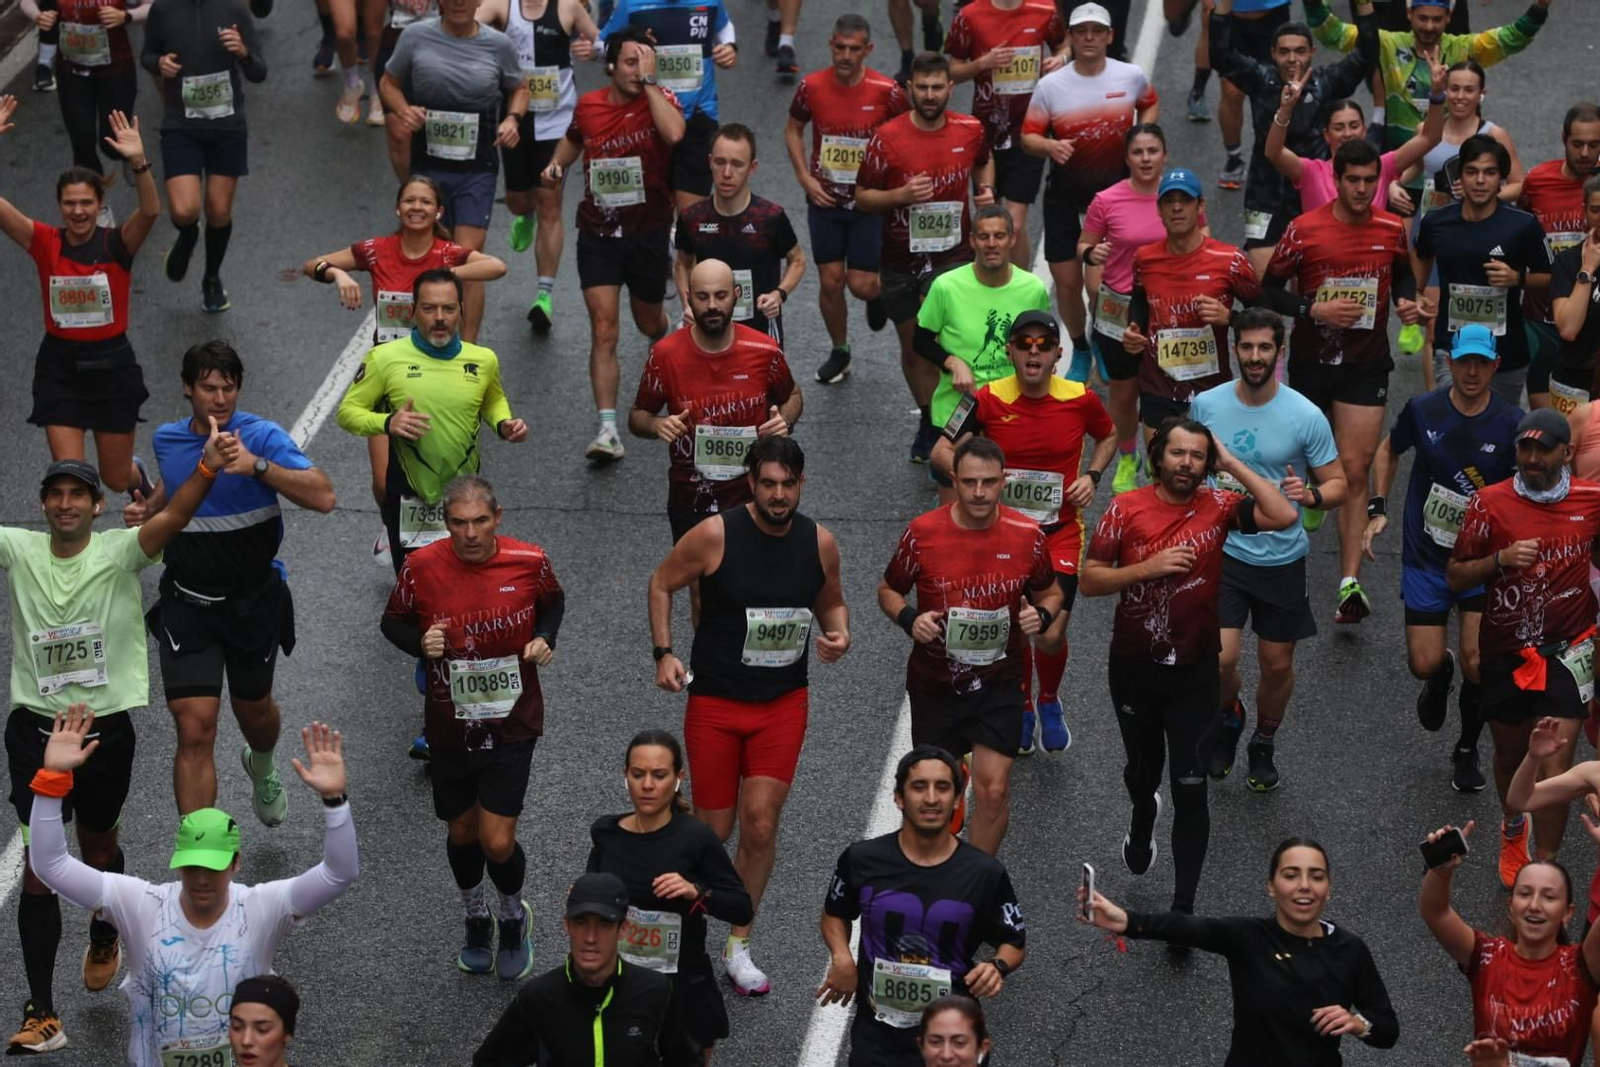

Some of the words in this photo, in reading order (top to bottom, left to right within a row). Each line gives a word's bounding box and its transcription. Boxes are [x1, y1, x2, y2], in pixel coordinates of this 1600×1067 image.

[689, 15, 708, 27] CN
[690, 27, 707, 38] PN
[659, 56, 691, 72] 9350
[190, 84, 222, 101] 7356
[433, 122, 466, 139] 9821
[825, 147, 865, 164] 12019
[597, 170, 630, 186] 9190
[918, 214, 951, 230] 8242
[58, 289, 96, 305] 8804
[1456, 297, 1494, 314] 9075
[1162, 340, 1208, 359] 14739
[705, 439, 744, 457] 9869
[1007, 482, 1053, 502] 10162
[757, 623, 797, 641] 9497
[958, 623, 998, 641] 7959
[43, 640, 88, 665] 7725
[456, 671, 510, 694] 10389
[884, 978, 932, 1003] 8685
[173, 1050, 225, 1067] 7289
